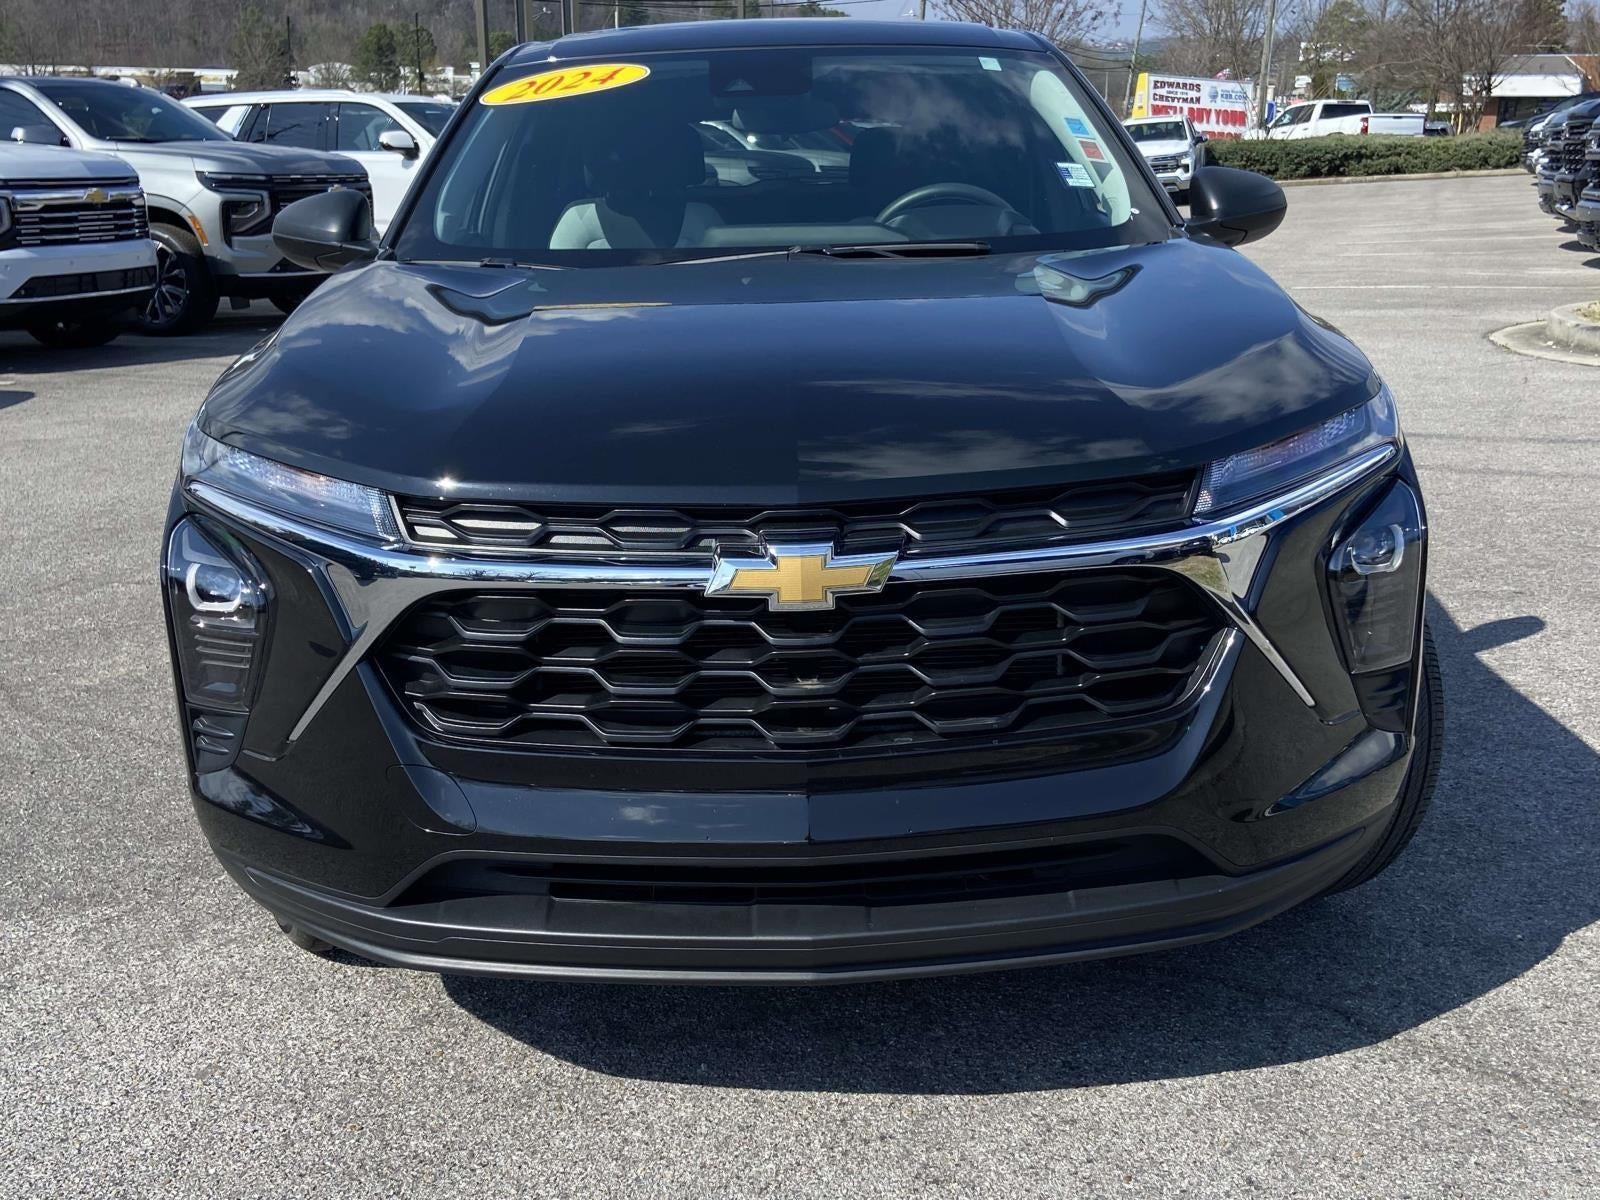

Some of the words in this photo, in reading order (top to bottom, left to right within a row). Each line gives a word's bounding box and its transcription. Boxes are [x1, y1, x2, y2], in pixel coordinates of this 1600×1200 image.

[503, 67, 625, 101] 2024
[1153, 80, 1201, 93] EDWARDS
[1152, 93, 1201, 105] CHEVYMAN
[1187, 106, 1212, 124] BUY
[1214, 107, 1248, 127] YOUR
